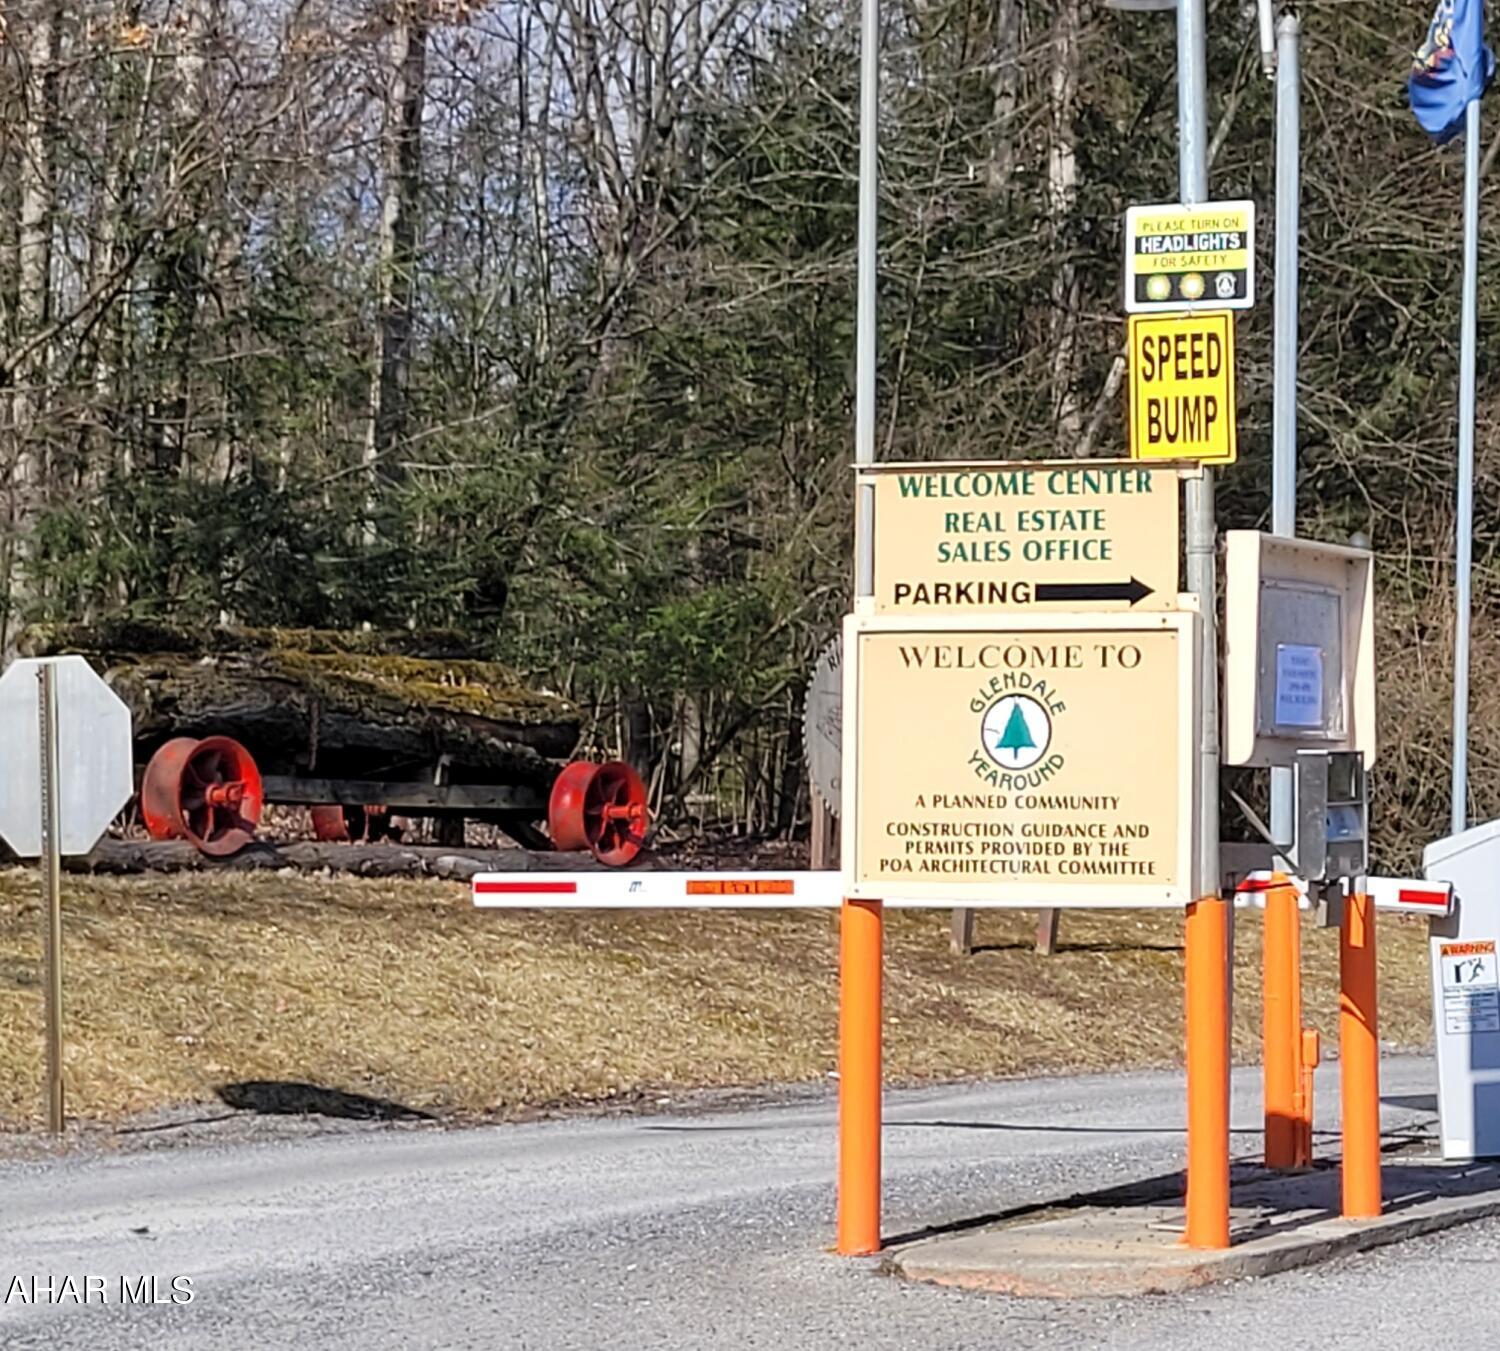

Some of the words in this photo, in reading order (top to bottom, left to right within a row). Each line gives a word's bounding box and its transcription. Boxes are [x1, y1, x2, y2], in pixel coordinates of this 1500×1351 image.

[1142, 221, 1186, 232] PLEASE
[1191, 219, 1219, 230] TURN
[1223, 217, 1239, 228] ON
[1141, 232, 1240, 253] HEADLIGHTS
[1153, 257, 1176, 267] FOR
[1181, 254, 1227, 267] SAFETY
[1142, 332, 1221, 382] SPEED
[1147, 395, 1218, 444] BUMP
[898, 471, 1036, 498] WELCOME
[1047, 469, 1153, 495] CENTER
[944, 511, 1006, 533] REAL
[1017, 509, 1106, 532] ESTATE
[937, 540, 1011, 563] SALES
[1022, 539, 1112, 561] OFFICE
[894, 582, 1031, 605] PARKING
[898, 644, 1083, 669] WELCOME
[1093, 644, 1142, 668] TO
[969, 671, 1066, 717] GLENDALE
[967, 749, 1065, 791] YEAROUND
[915, 794, 926, 809] A
[933, 794, 1007, 809] PLANNED
[1014, 795, 1120, 810] COMMUNITY
[886, 822, 1014, 838] CONSTRUCTION
[1021, 823, 1107, 838] GUIDANCE
[1113, 823, 1150, 839] AND
[905, 840, 974, 855] PERMITS
[981, 841, 1065, 856] PROVIDED
[1072, 842, 1094, 856] BY
[1099, 842, 1130, 856] THE
[880, 858, 913, 873] POA
[919, 858, 1051, 874] ARCHITECTURAL
[1058, 860, 1156, 875] COMMITTEE
[1450, 942, 1495, 955] WARNING
